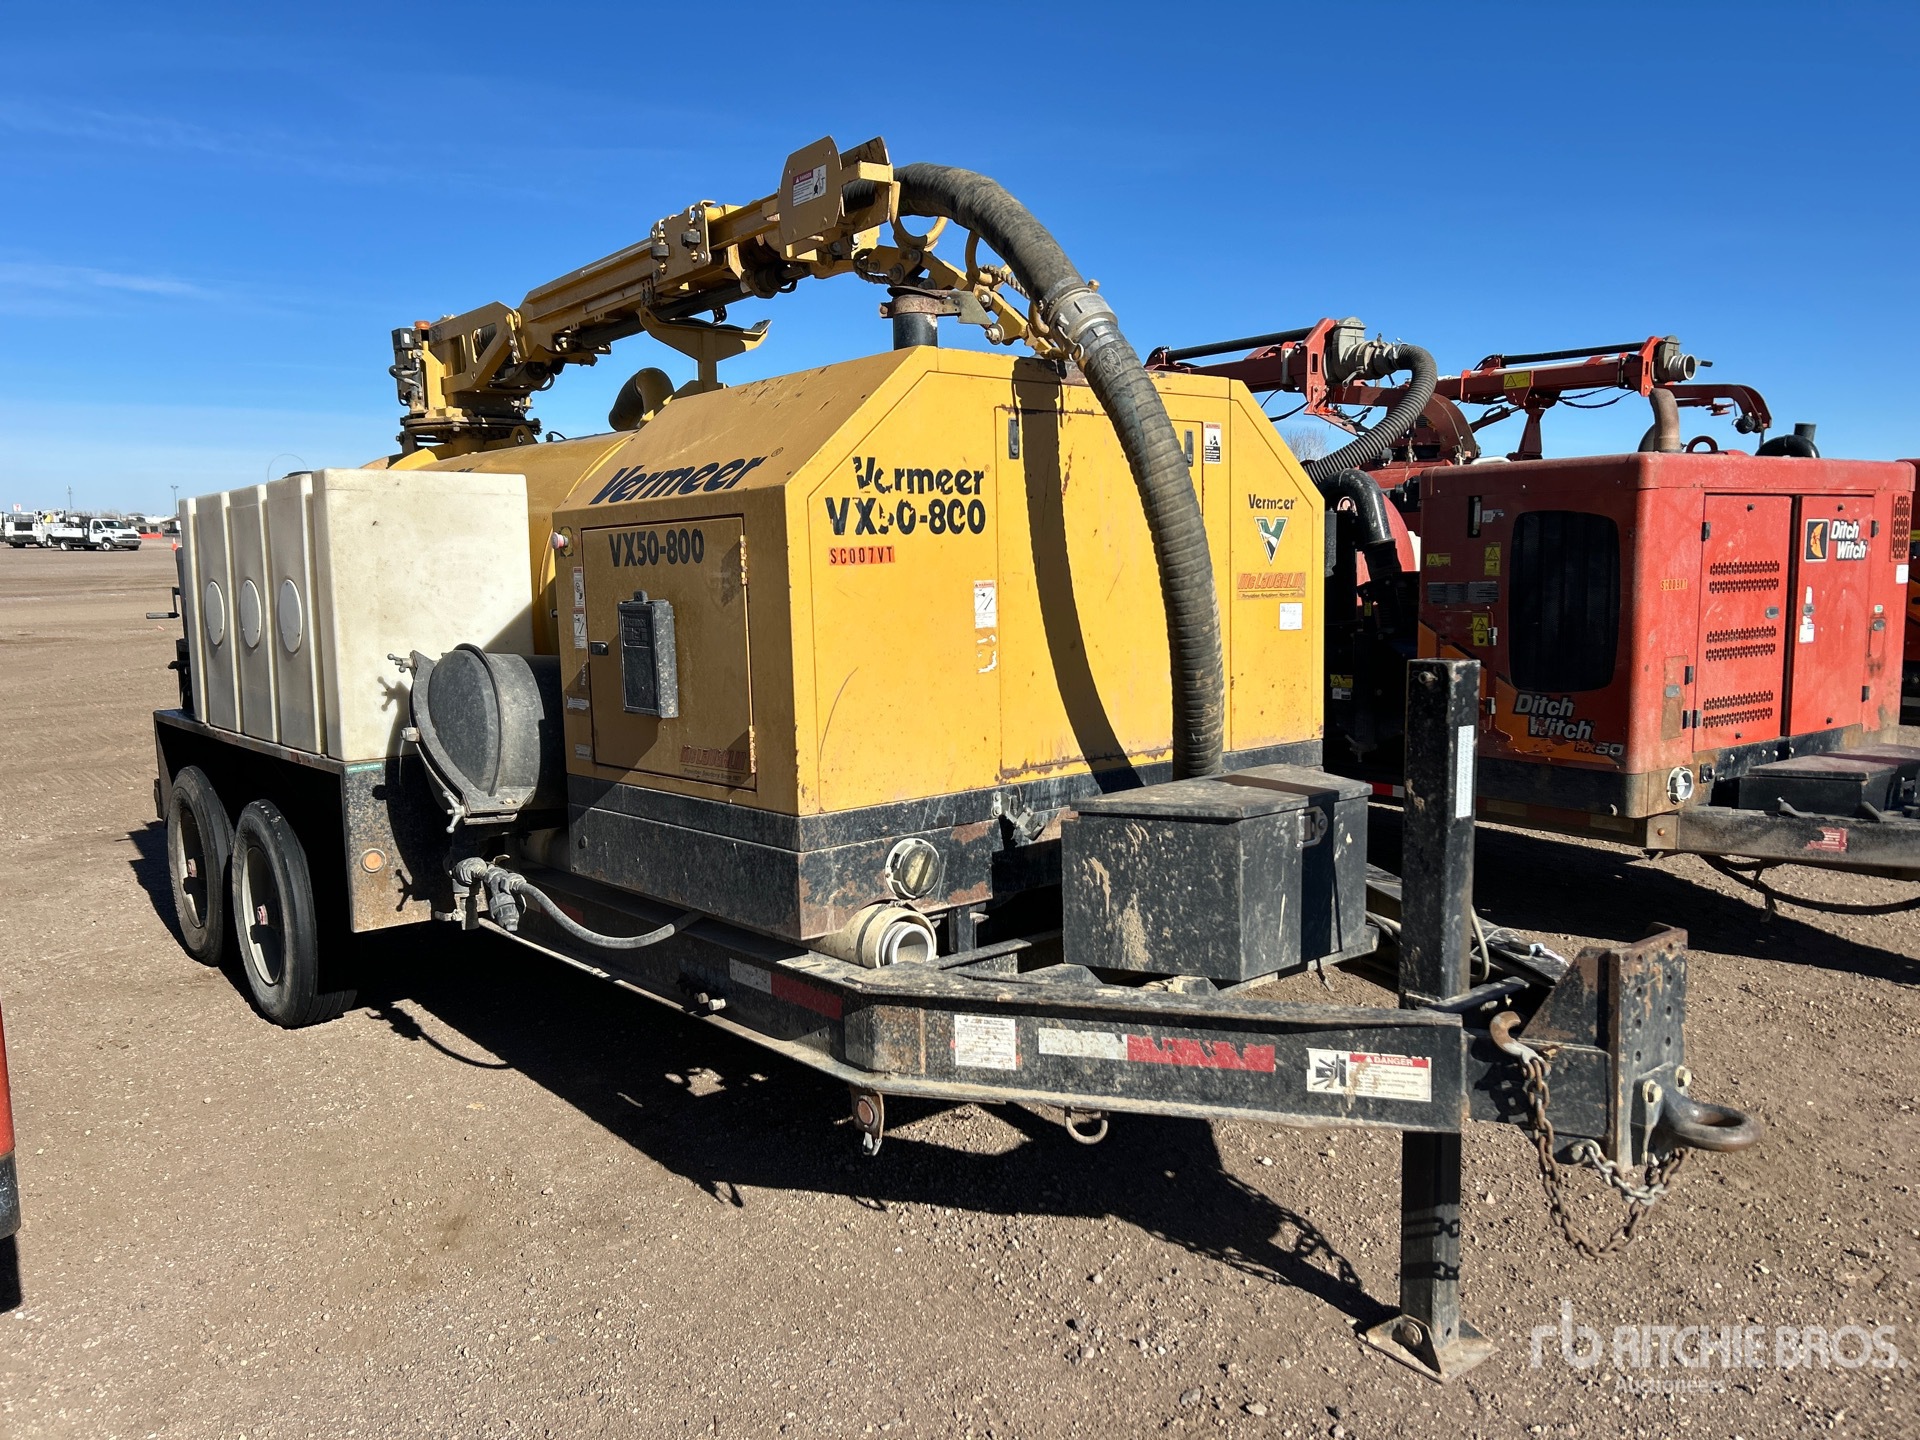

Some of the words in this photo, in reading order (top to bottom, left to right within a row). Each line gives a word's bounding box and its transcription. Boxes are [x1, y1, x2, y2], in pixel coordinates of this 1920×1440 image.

[588, 456, 768, 505] Vermeer
[1248, 494, 1295, 510] Vermeer
[1830, 520, 1860, 540] Ditch
[608, 528, 704, 567] VX50-800
[830, 547, 893, 565] SC007VT
[1836, 540, 1867, 560] Witch
[1514, 693, 1575, 717] Ditch
[1529, 715, 1592, 740] Witch
[1375, 1055, 1413, 1067] DANGER
